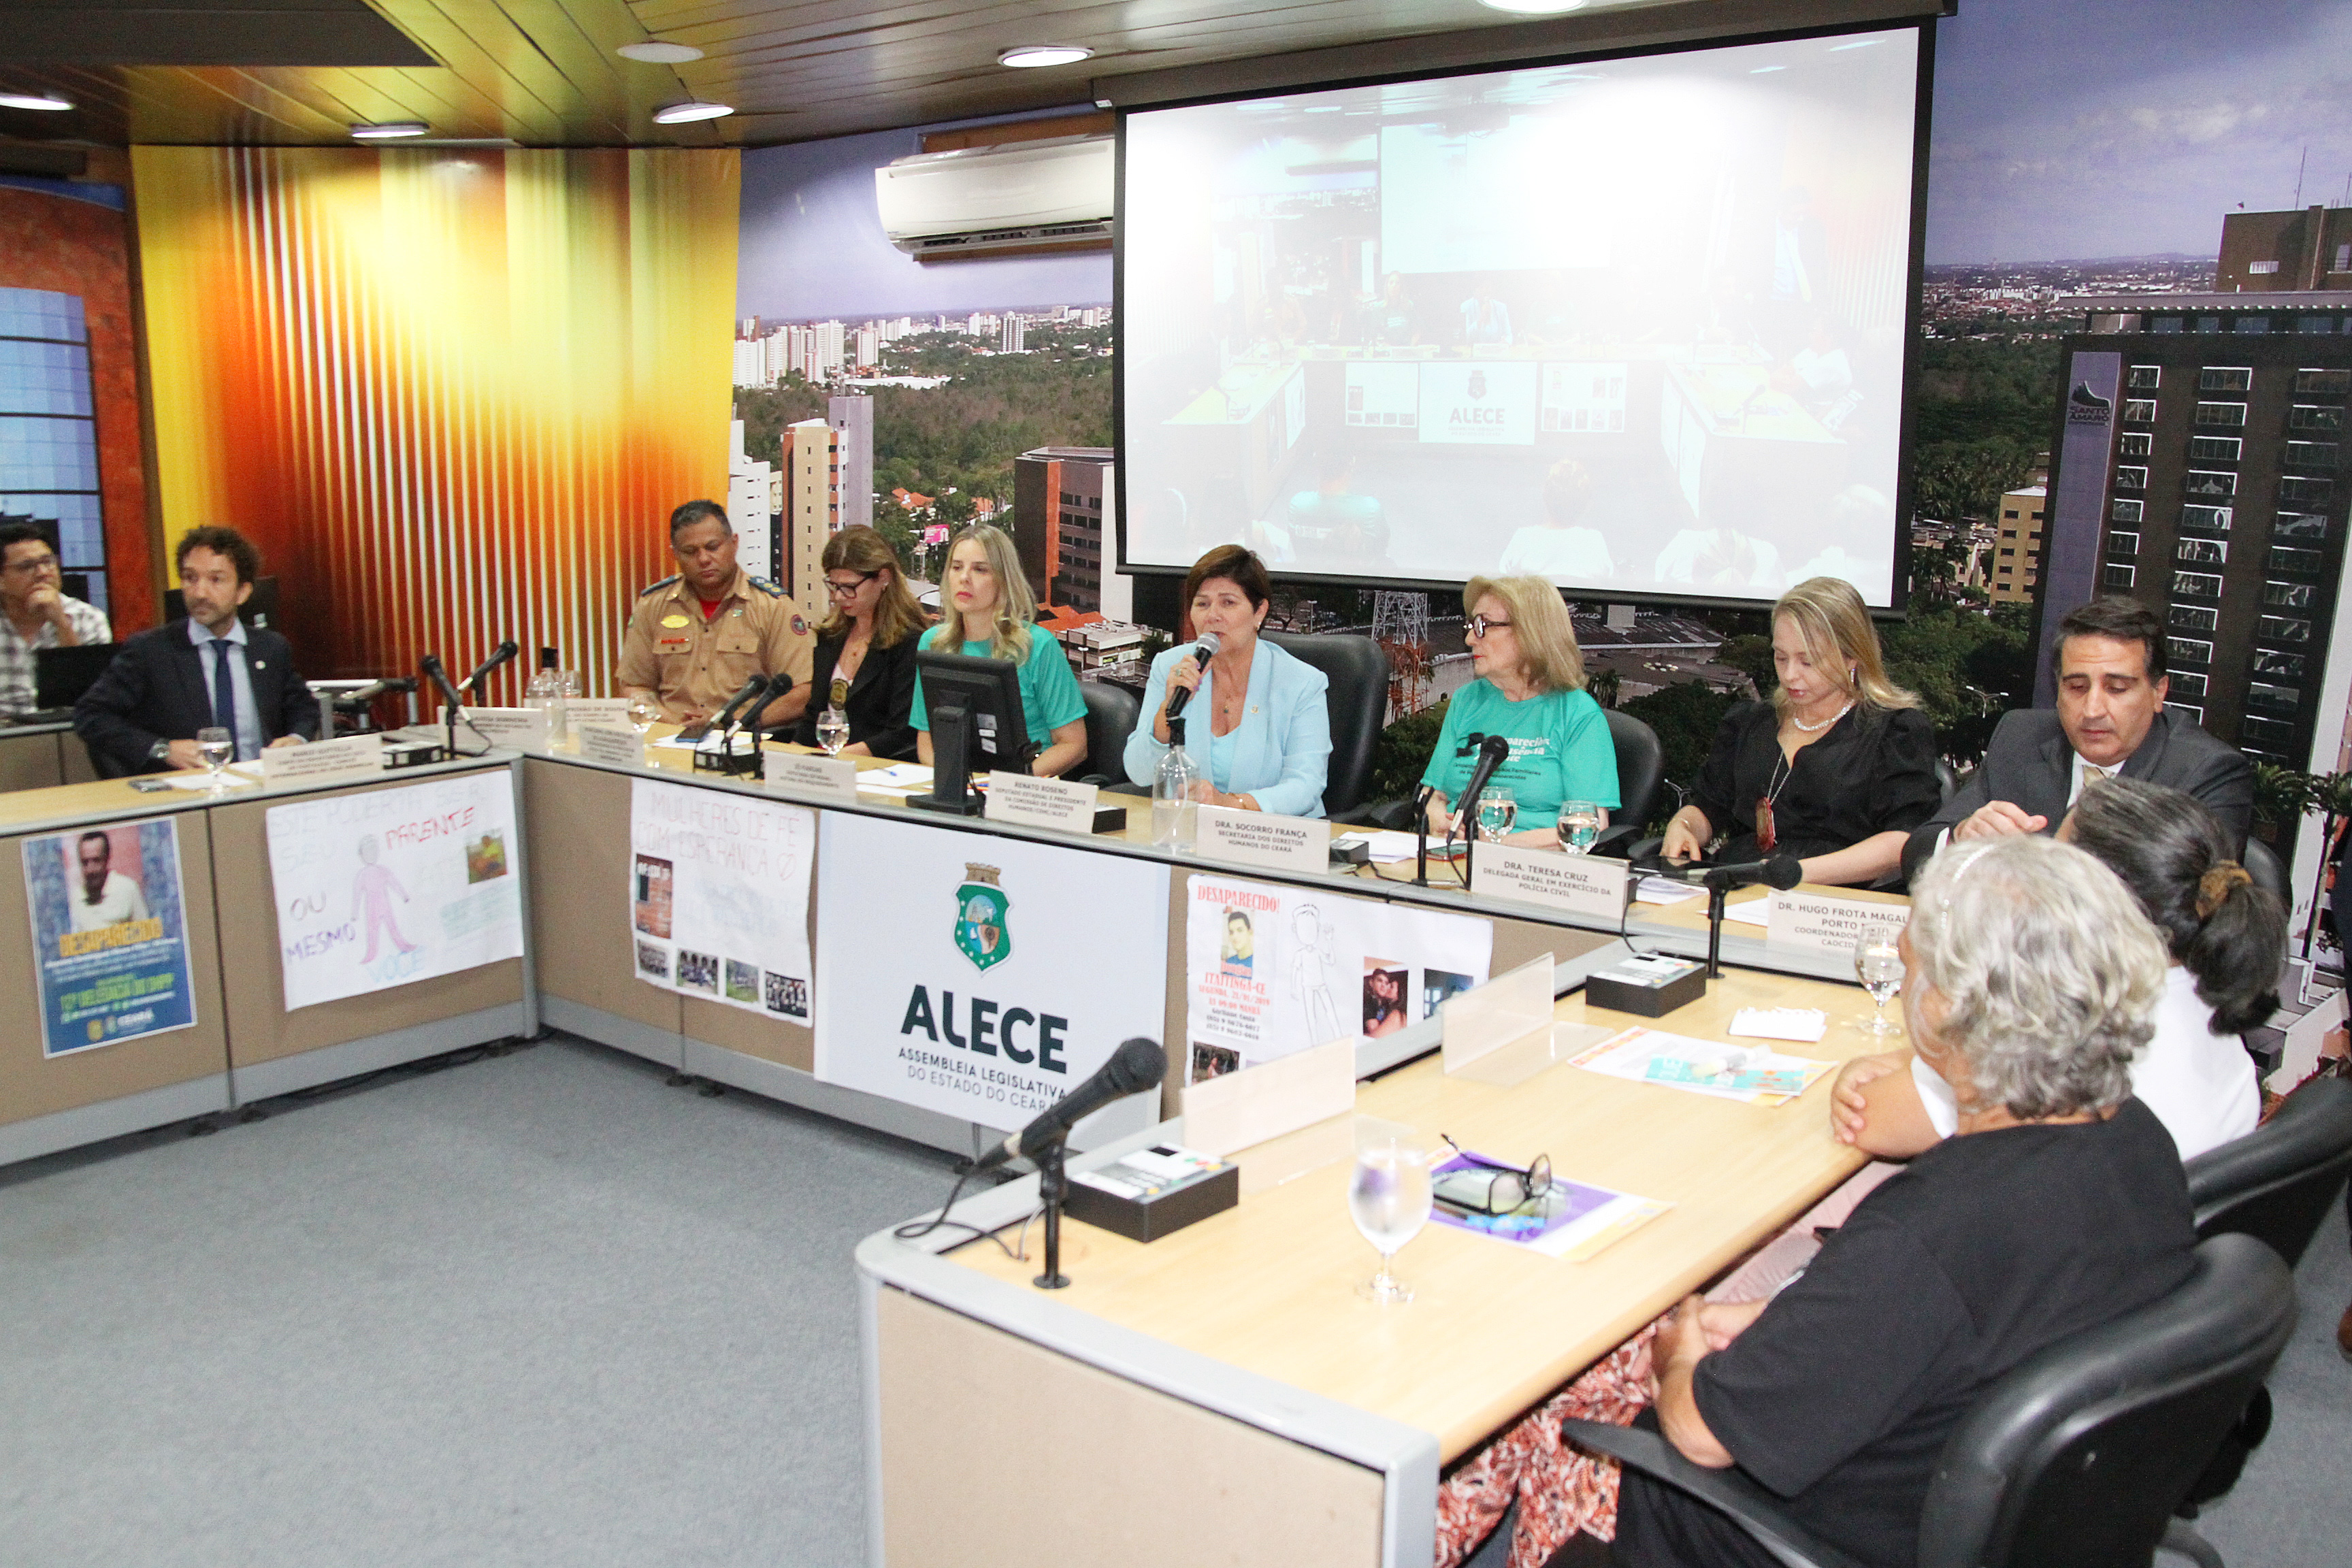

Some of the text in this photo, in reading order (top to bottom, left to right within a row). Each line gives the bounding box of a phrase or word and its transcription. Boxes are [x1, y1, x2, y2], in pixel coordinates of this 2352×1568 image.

[1448, 408, 1505, 425] ALECE
[1015, 782, 1068, 795] RENATO ROSENO
[385, 806, 475, 850] PARENTE
[1215, 819, 1307, 839] DRA. SOCORRO FRANÇA
[1218, 830, 1304, 847] SECRETARIA DOS DIREITOS
[1228, 839, 1259, 849] HUMANOS
[1483, 867, 1520, 879] DELEGADA
[1522, 874, 1544, 884] GERAL
[1558, 879, 1599, 894] EXERCÍCIO
[1601, 887, 1612, 896] DA
[1504, 860, 1588, 883] DRA. TERESA CRUZ
[1198, 885, 1280, 913] DESAPARECIDO!
[1519, 882, 1570, 898] POLÍCIA CIVIL
[289, 890, 327, 921] OU
[1778, 902, 1907, 924] DR. HUGO FROTA MAGAL
[1822, 918, 1858, 930] PORTO
[285, 922, 357, 964] MESMO
[1205, 972, 1266, 995] ITAITINGA-CE
[900, 984, 1068, 1075] ALECE
[898, 1047, 1067, 1101] ASSEMBLEIA LEGISLATIVA
[907, 1064, 926, 1081] DO
[930, 1071, 981, 1096] ESTADO
[986, 1085, 1006, 1102] DO
